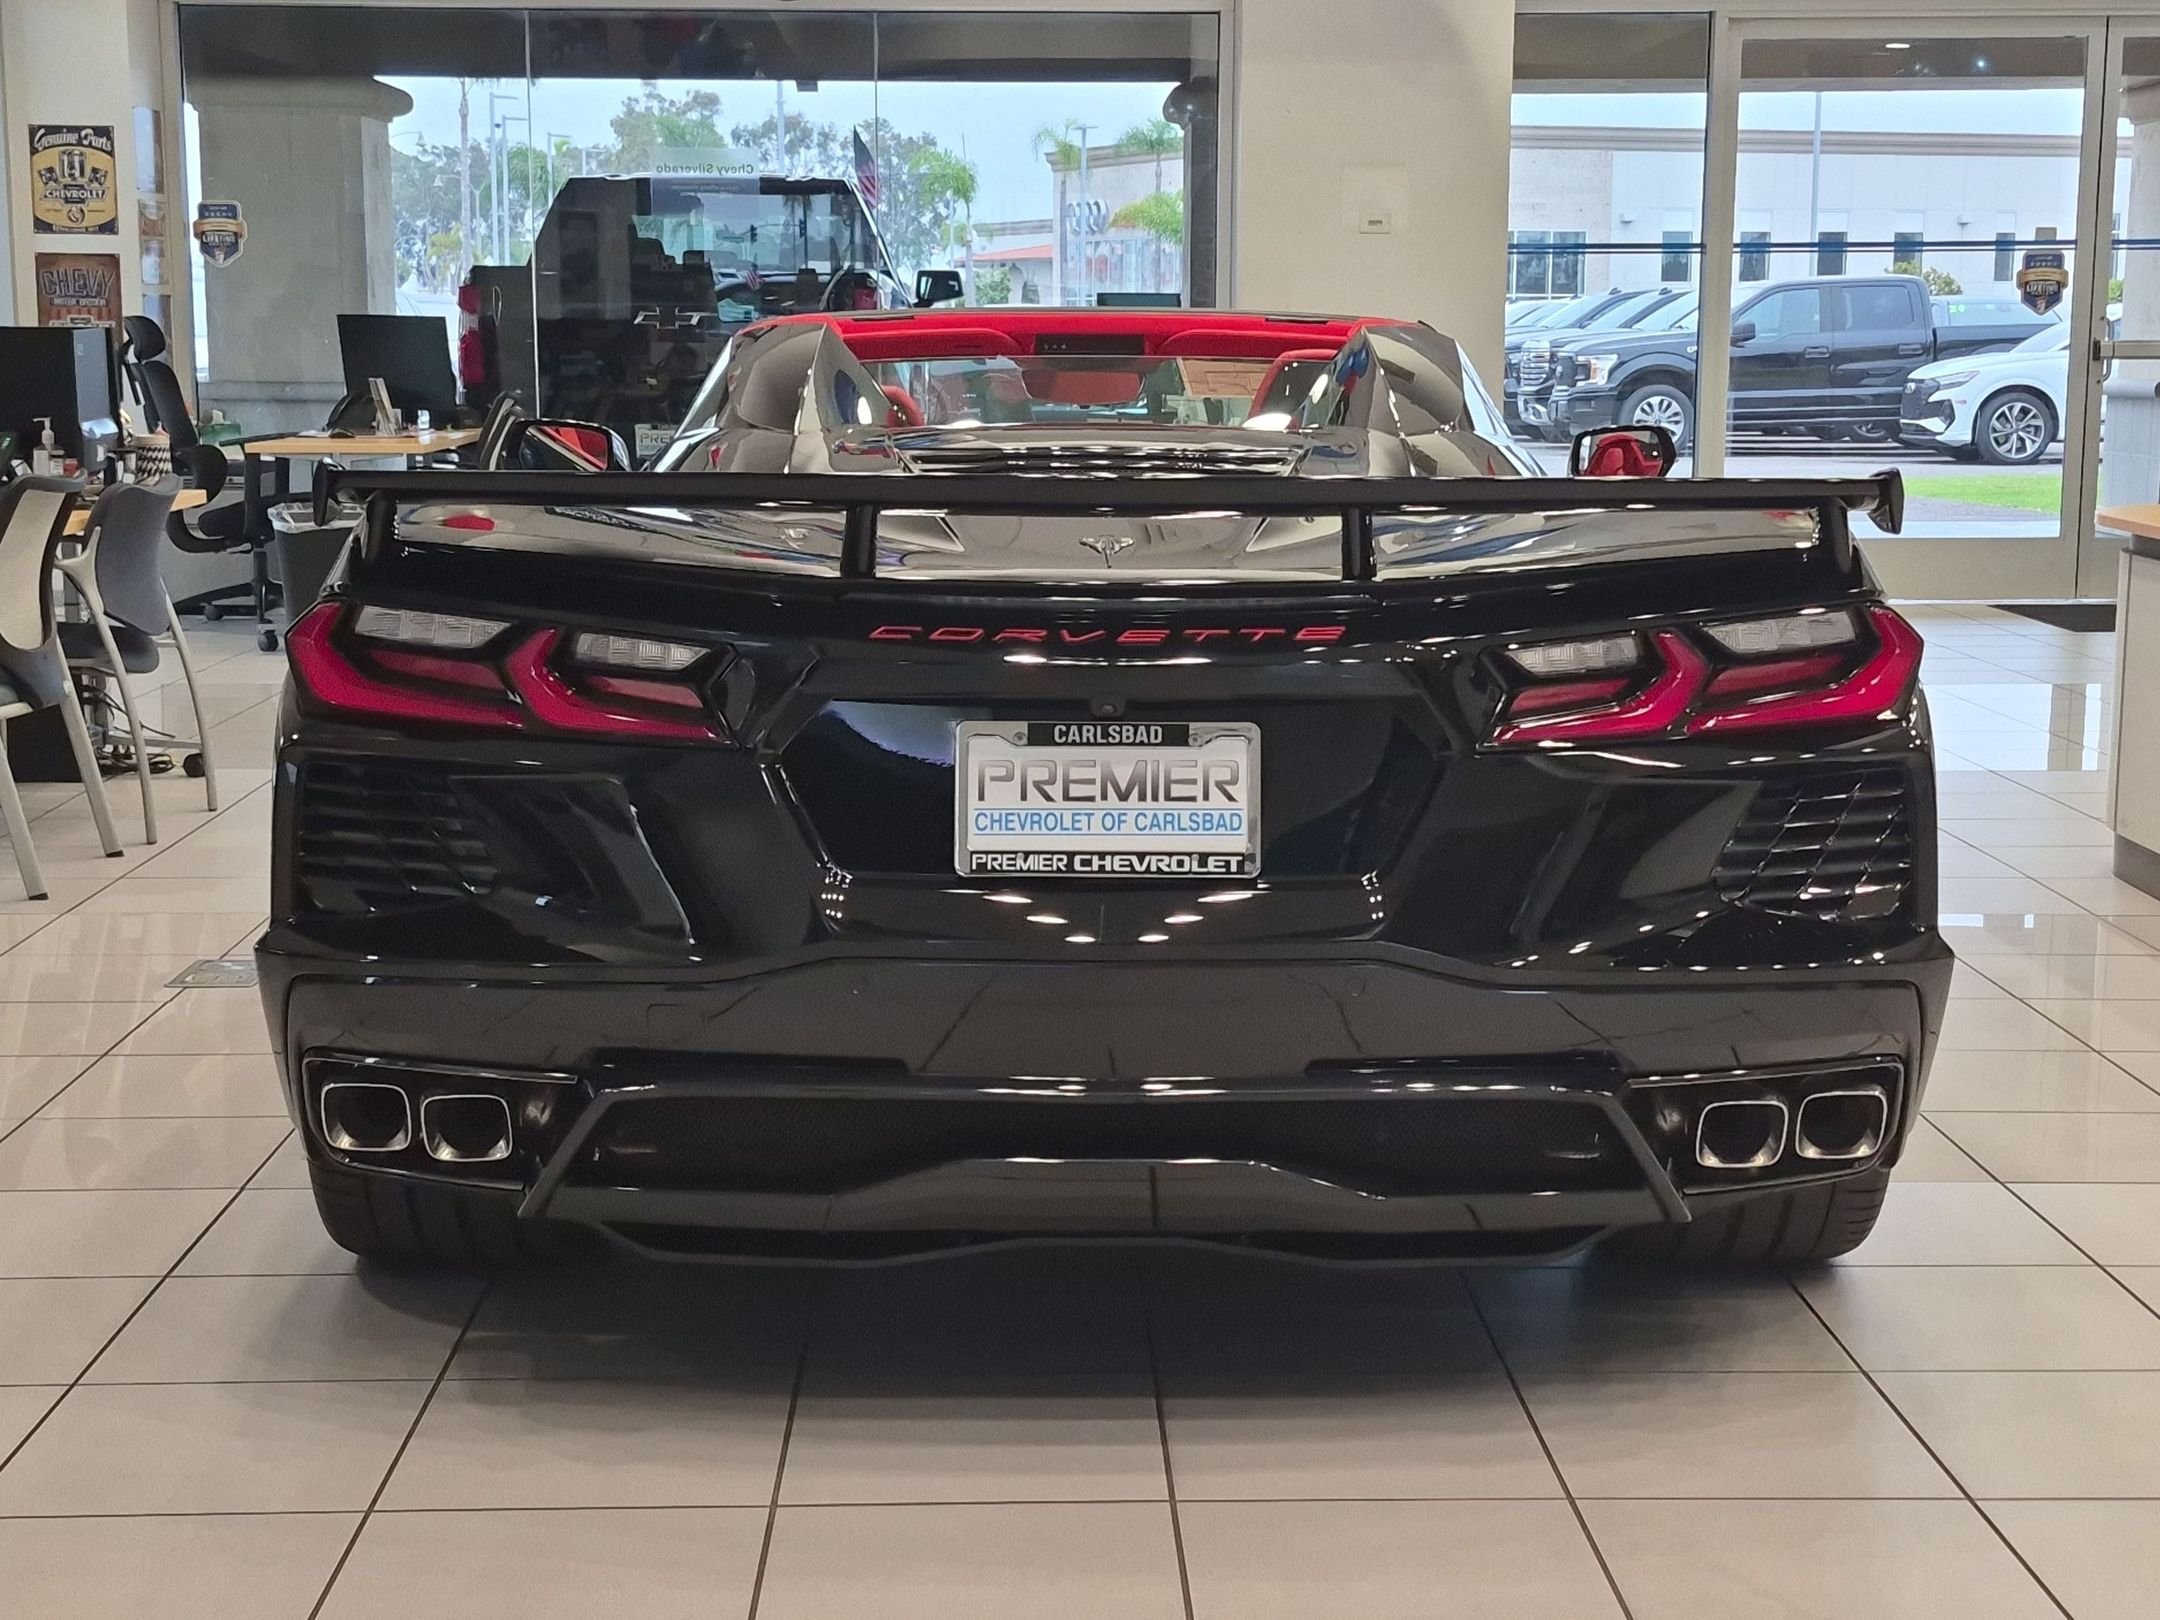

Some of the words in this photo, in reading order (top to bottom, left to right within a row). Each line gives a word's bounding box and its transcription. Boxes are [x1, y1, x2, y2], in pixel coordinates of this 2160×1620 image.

[34, 128, 78, 151] Genuine
[81, 128, 112, 151] Parts
[46, 189, 104, 199] CHEVROLET
[41, 266, 115, 298] CHEVY
[640, 433, 674, 444] PRE
[869, 625, 1346, 645] CORVETTE
[1053, 725, 1163, 744] CARLSBAD
[977, 759, 1240, 802] PREMIER
[974, 812, 1095, 832] CHEVROLET
[1101, 812, 1128, 832] OF
[1134, 812, 1243, 832] CARLSBAD
[971, 853, 1067, 871] PREMIER
[1073, 854, 1243, 873] CHEVROLET
